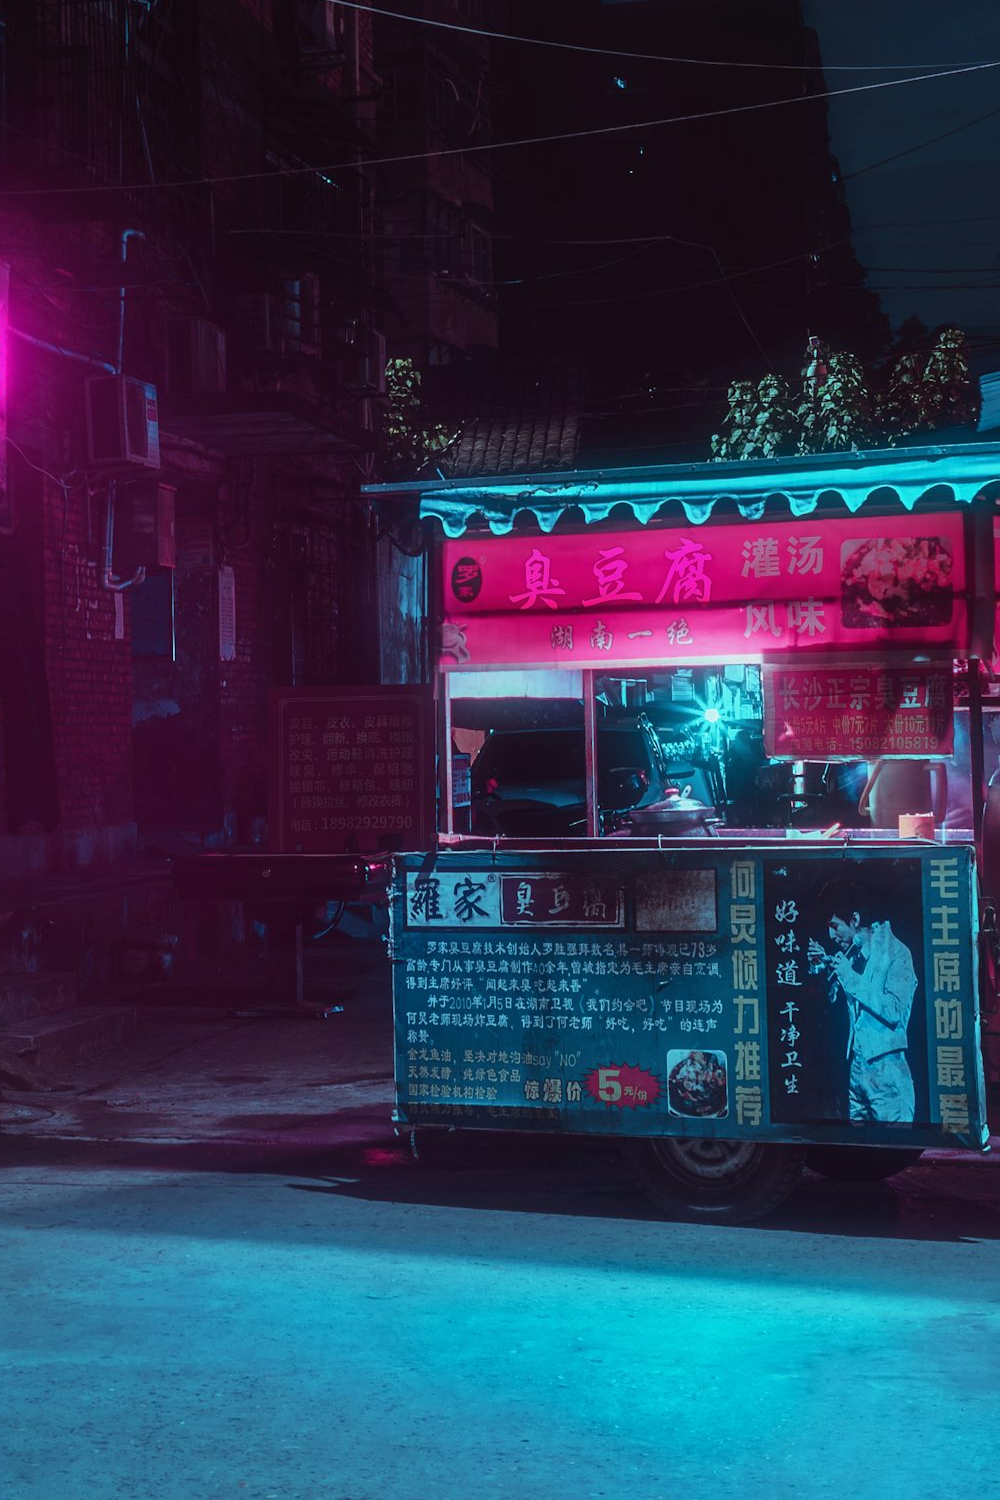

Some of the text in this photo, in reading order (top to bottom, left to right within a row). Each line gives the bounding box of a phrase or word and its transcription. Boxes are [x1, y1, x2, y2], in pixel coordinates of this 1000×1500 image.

[509, 537, 712, 610] 臭豆腐
[741, 536, 824, 579] 灌汤
[551, 619, 694, 651] 湖南一绝
[743, 597, 826, 639] 风味
[779, 674, 947, 711] 长沙正宗臭豆腐
[411, 877, 607, 922] 羅家 臭豆腐
[730, 860, 762, 1126] 何炅倾力推荐
[774, 900, 802, 1095] 好味道 干净卫生
[930, 858, 970, 1134] 毛主席的最爱
[408, 1083, 498, 1101] 国家检验机构检验
[524, 1077, 582, 1103] 惊爆价
